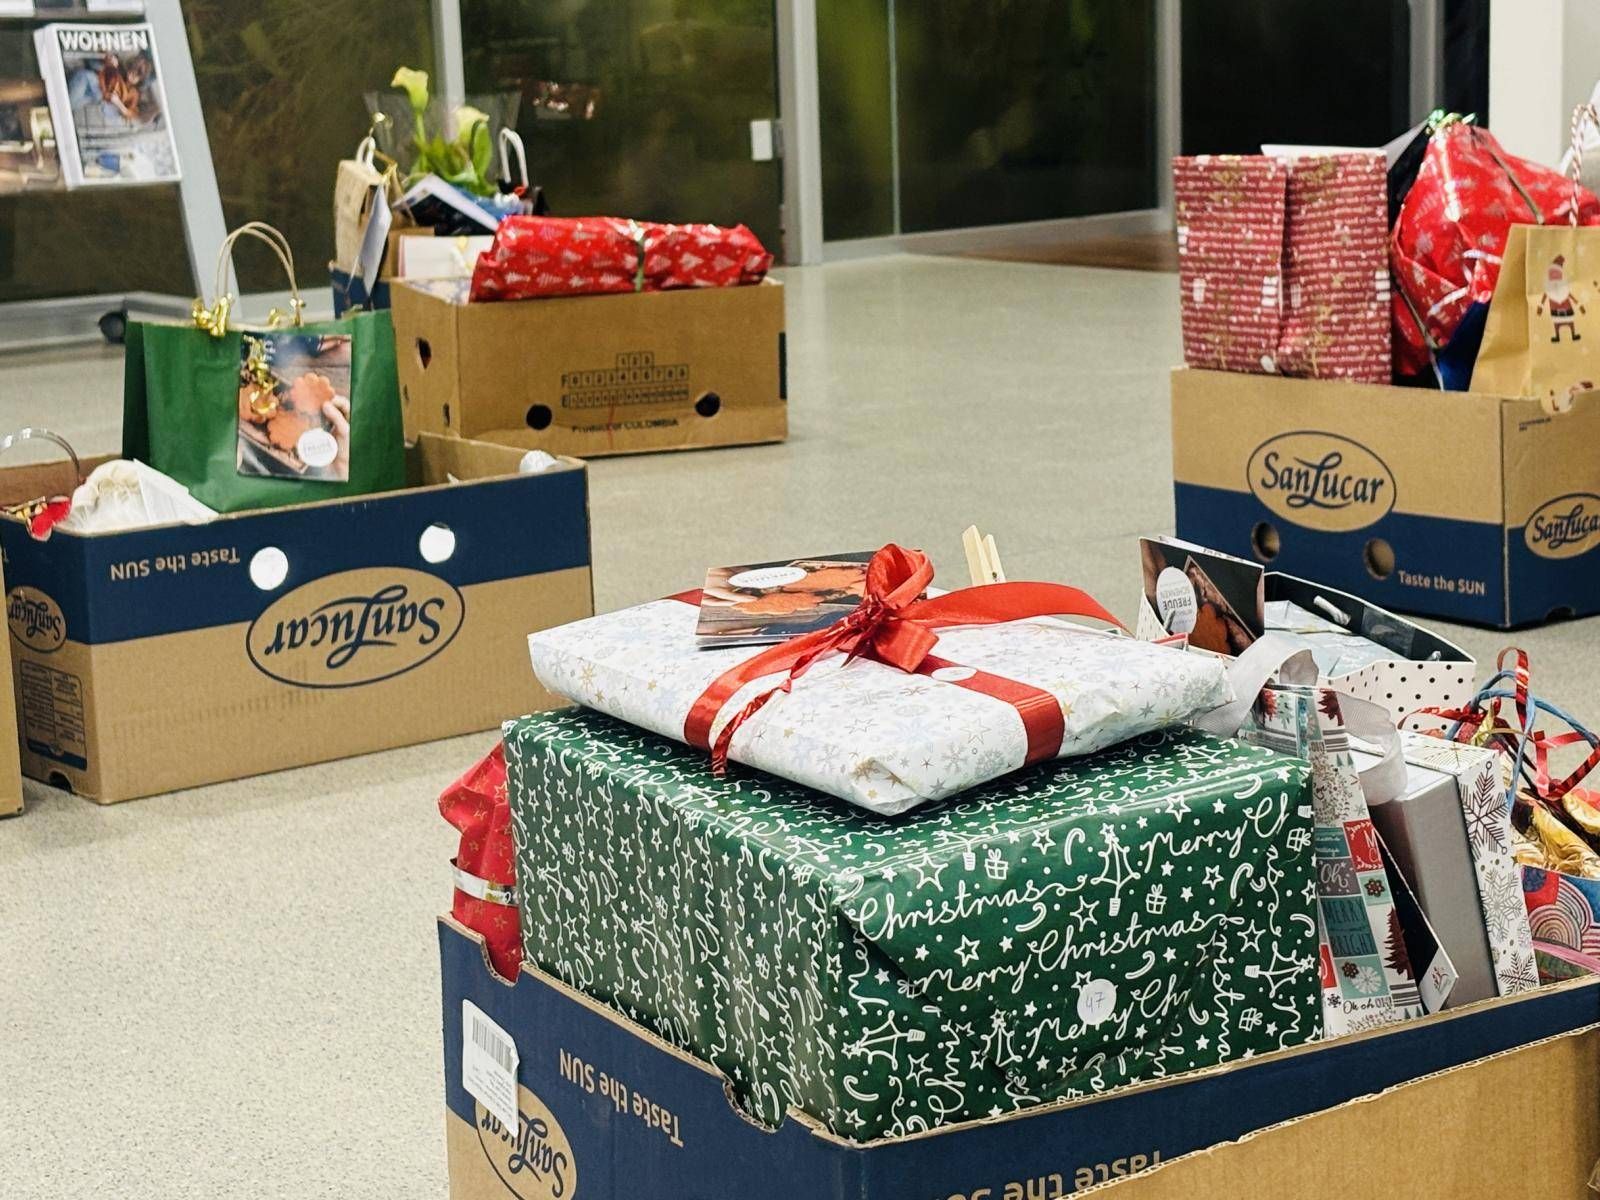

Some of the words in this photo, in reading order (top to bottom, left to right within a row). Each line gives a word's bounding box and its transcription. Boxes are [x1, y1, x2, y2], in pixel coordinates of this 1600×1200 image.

[60, 31, 148, 51] WOHNEN
[1261, 451, 1385, 509] SanLucar
[1532, 503, 1600, 550] SanLuca
[110, 559, 150, 581] SUN
[155, 555, 186, 574] the
[192, 547, 241, 565] Taste
[1162, 597, 1193, 611] FREUDE
[1399, 570, 1431, 588] Taste
[1433, 575, 1455, 592] the
[1458, 578, 1485, 596] SUN
[263, 584, 446, 669] SanLucar
[1140, 831, 1248, 874] Merry
[1321, 863, 1349, 889] Oh
[847, 874, 1089, 941] Christmas
[917, 953, 1031, 994] Merry
[1028, 911, 1244, 972] Christmas
[1086, 991, 1105, 1014] 47
[1027, 1006, 1130, 1060] Mey
[559, 1048, 595, 1095] SUN
[600, 1071, 628, 1114] the
[633, 1091, 684, 1148] Taste
